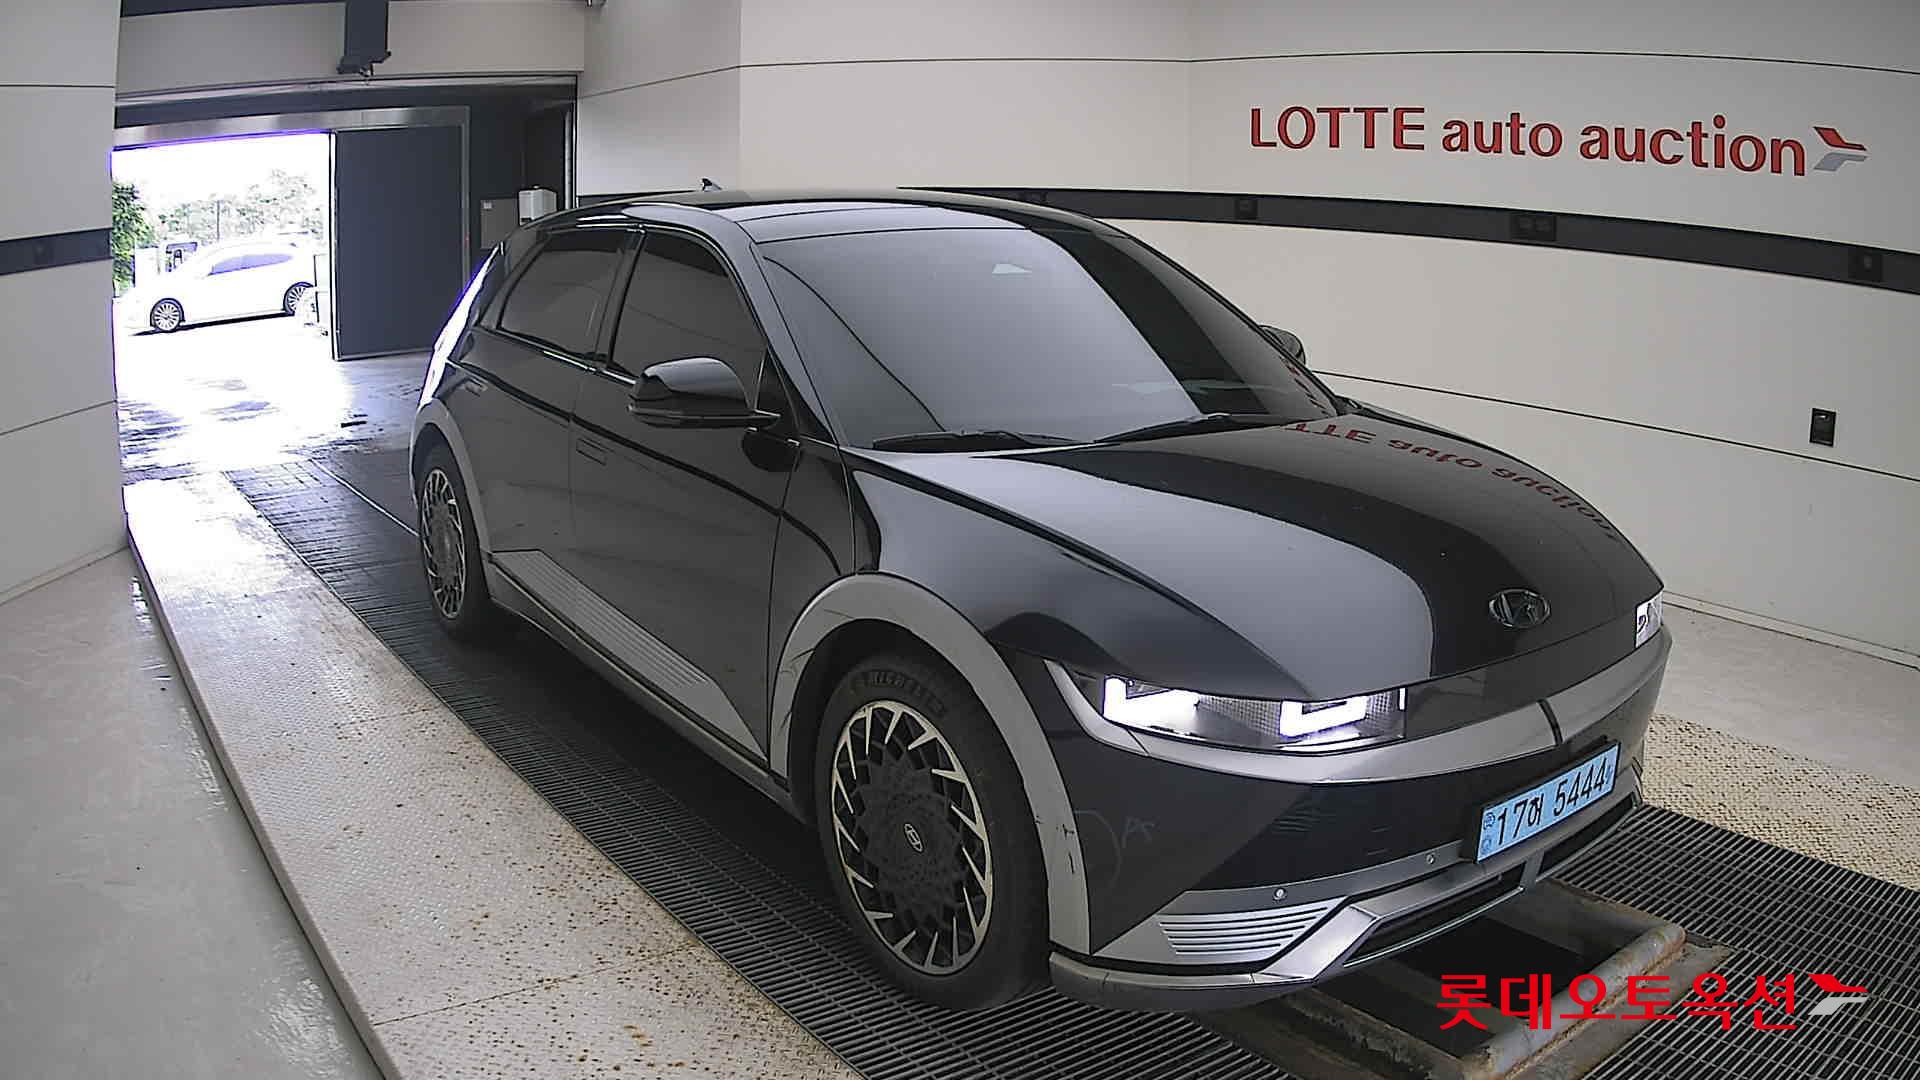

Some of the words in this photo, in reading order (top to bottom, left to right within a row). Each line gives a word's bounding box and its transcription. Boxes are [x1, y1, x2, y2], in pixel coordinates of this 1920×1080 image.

[1250, 106, 1426, 151] LOTTE
[1440, 112, 1563, 158] auto
[1578, 114, 1806, 177] auction
[1497, 792, 1545, 846] 17허
[1553, 757, 1607, 817] 5444
